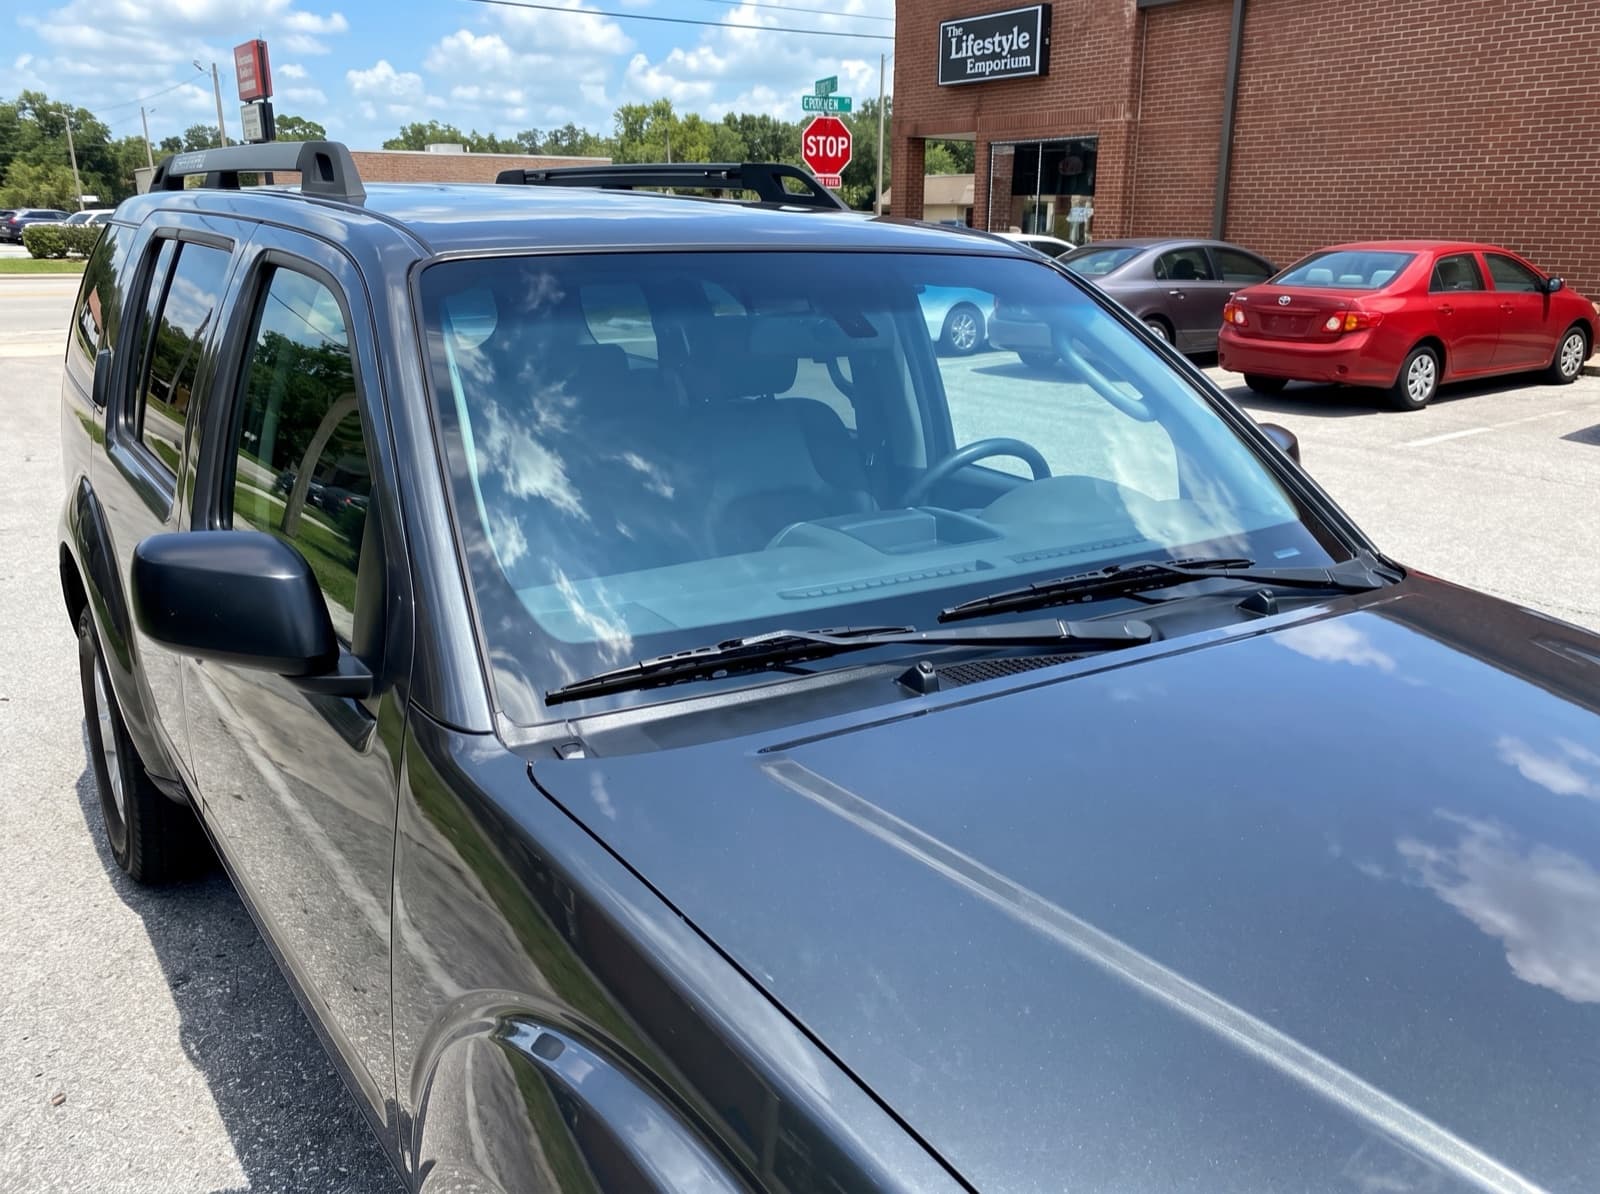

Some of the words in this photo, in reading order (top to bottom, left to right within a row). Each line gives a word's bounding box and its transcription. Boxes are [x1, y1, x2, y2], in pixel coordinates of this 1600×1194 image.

[946, 25, 963, 38] The
[949, 25, 1030, 60] Lifestyle
[966, 54, 1031, 76] Emporium
[806, 135, 848, 158] STOP
